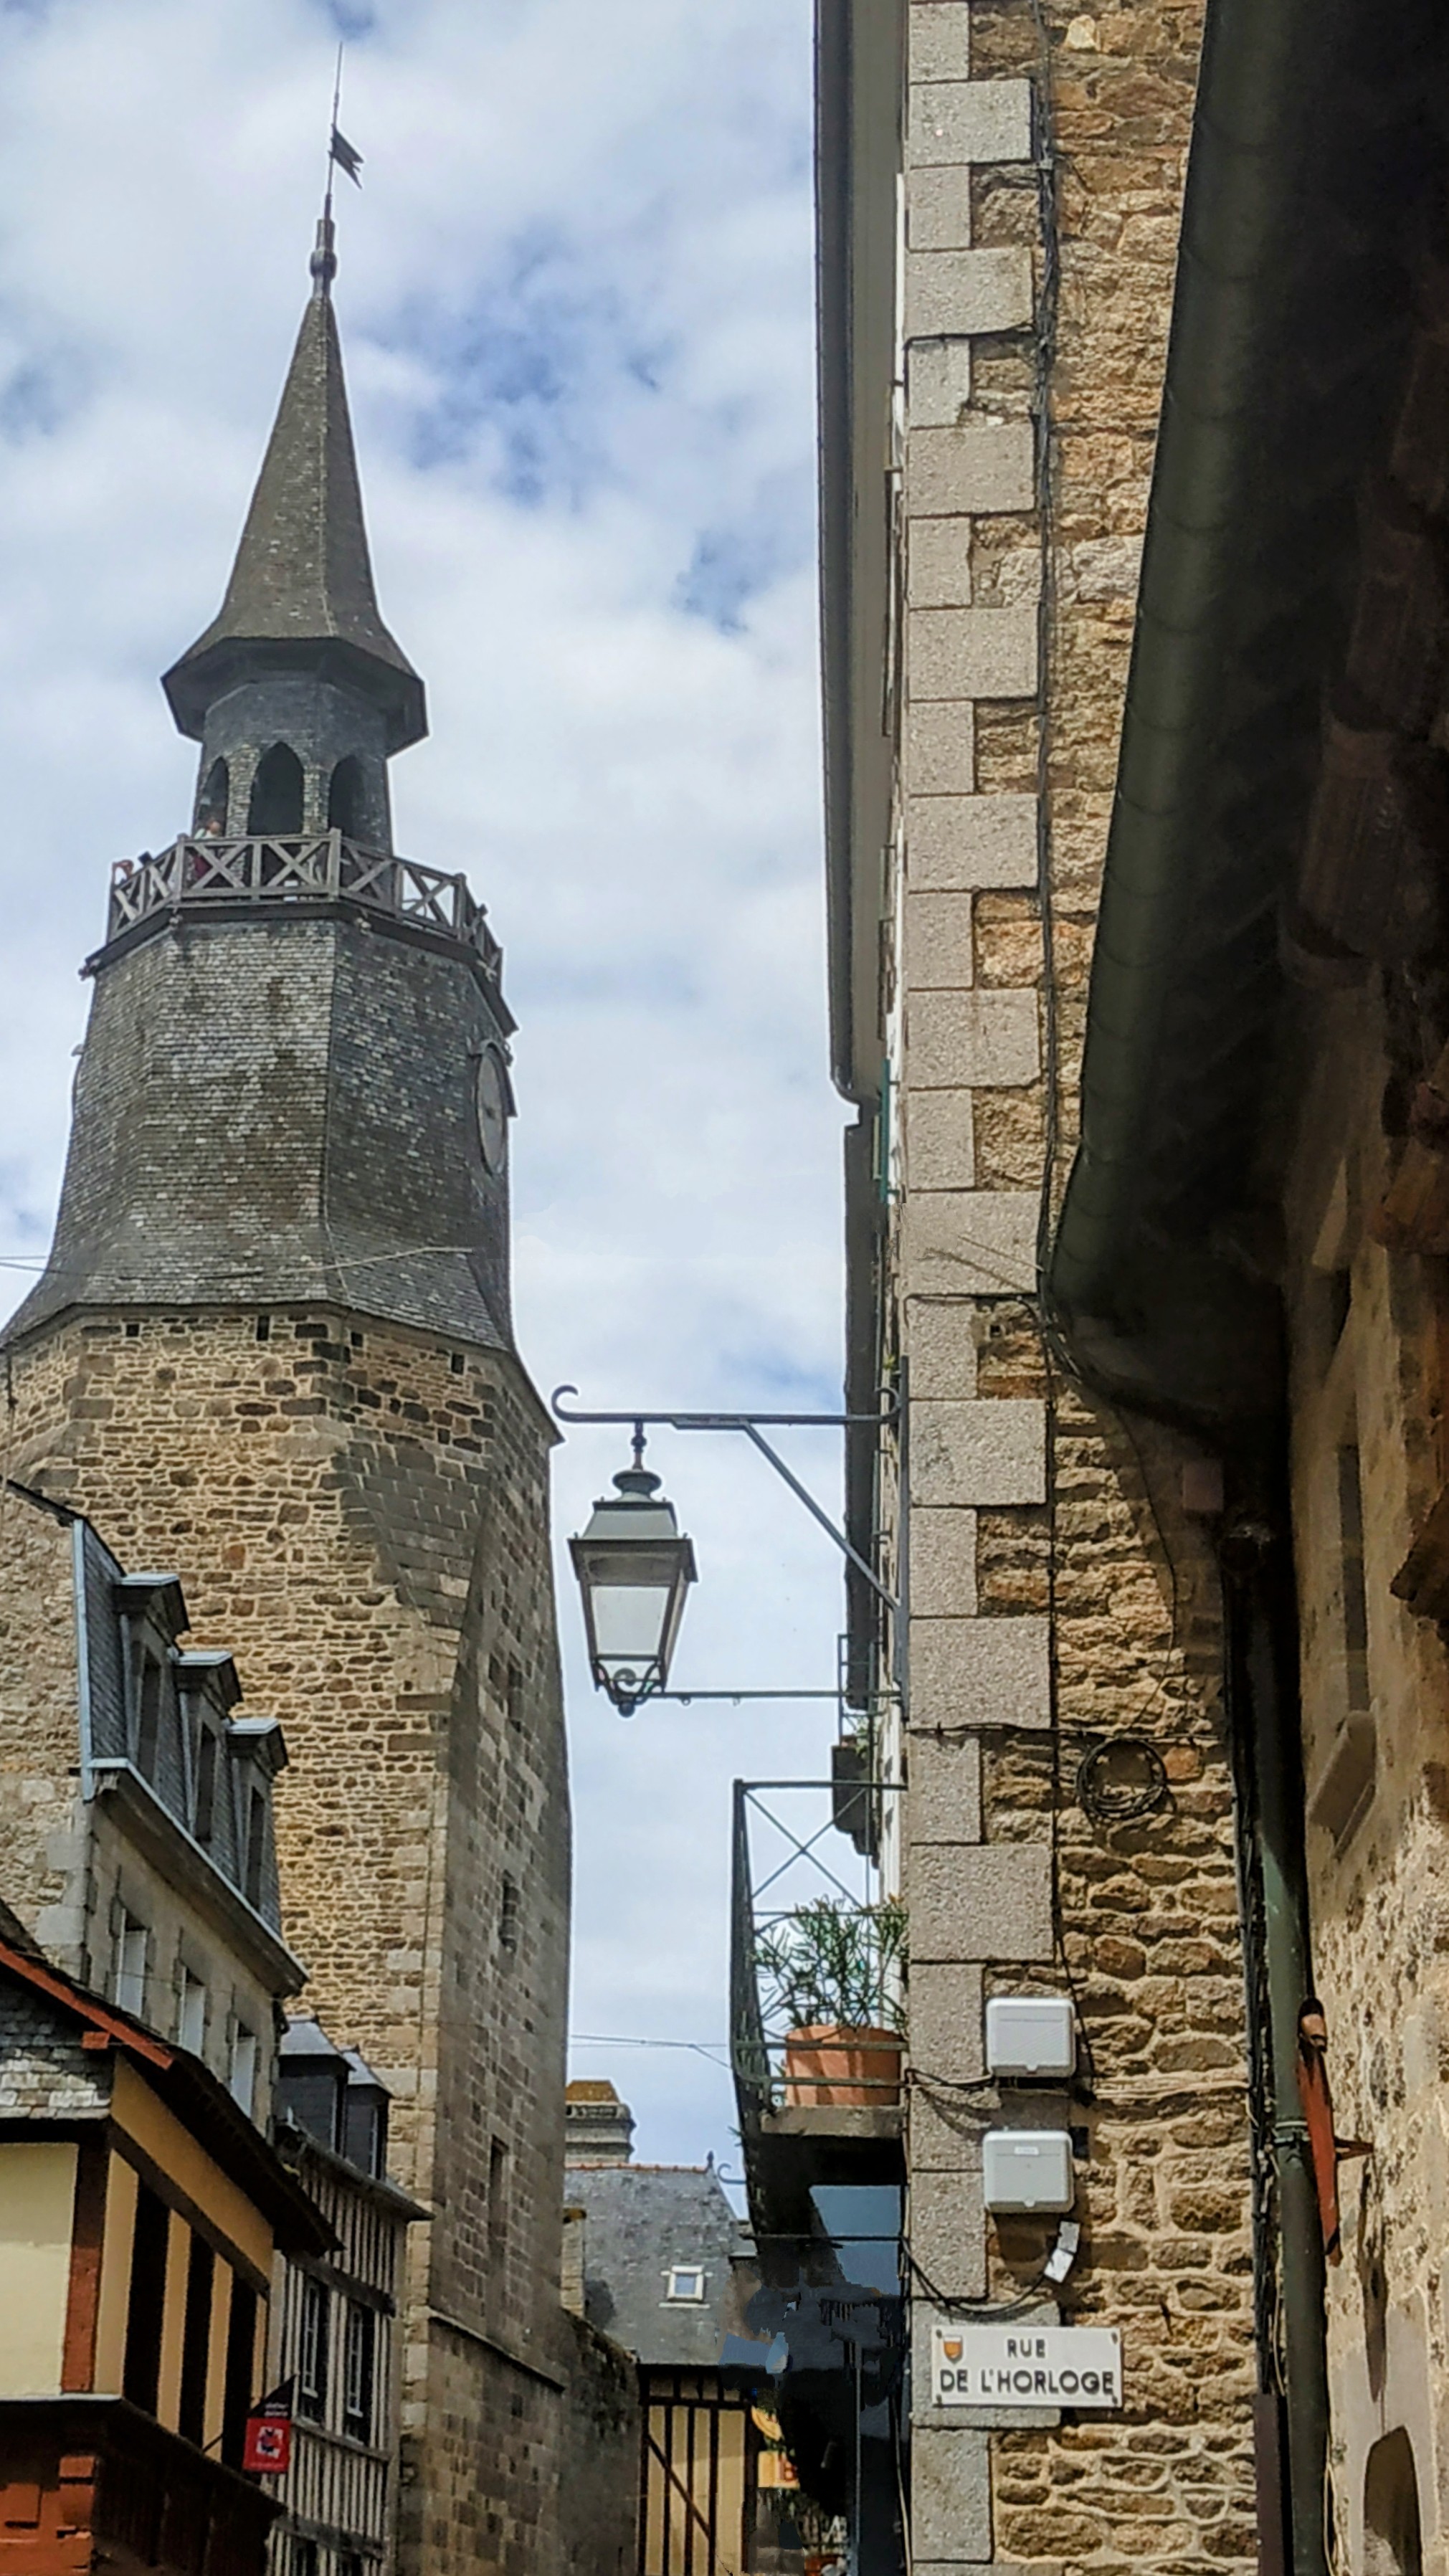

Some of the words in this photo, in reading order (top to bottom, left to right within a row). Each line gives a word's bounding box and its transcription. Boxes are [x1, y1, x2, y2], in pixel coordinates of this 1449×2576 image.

[1007, 2338, 1046, 2358] RUE
[940, 2369, 968, 2392] DE
[981, 2369, 1113, 2395] L'HORLOGE
